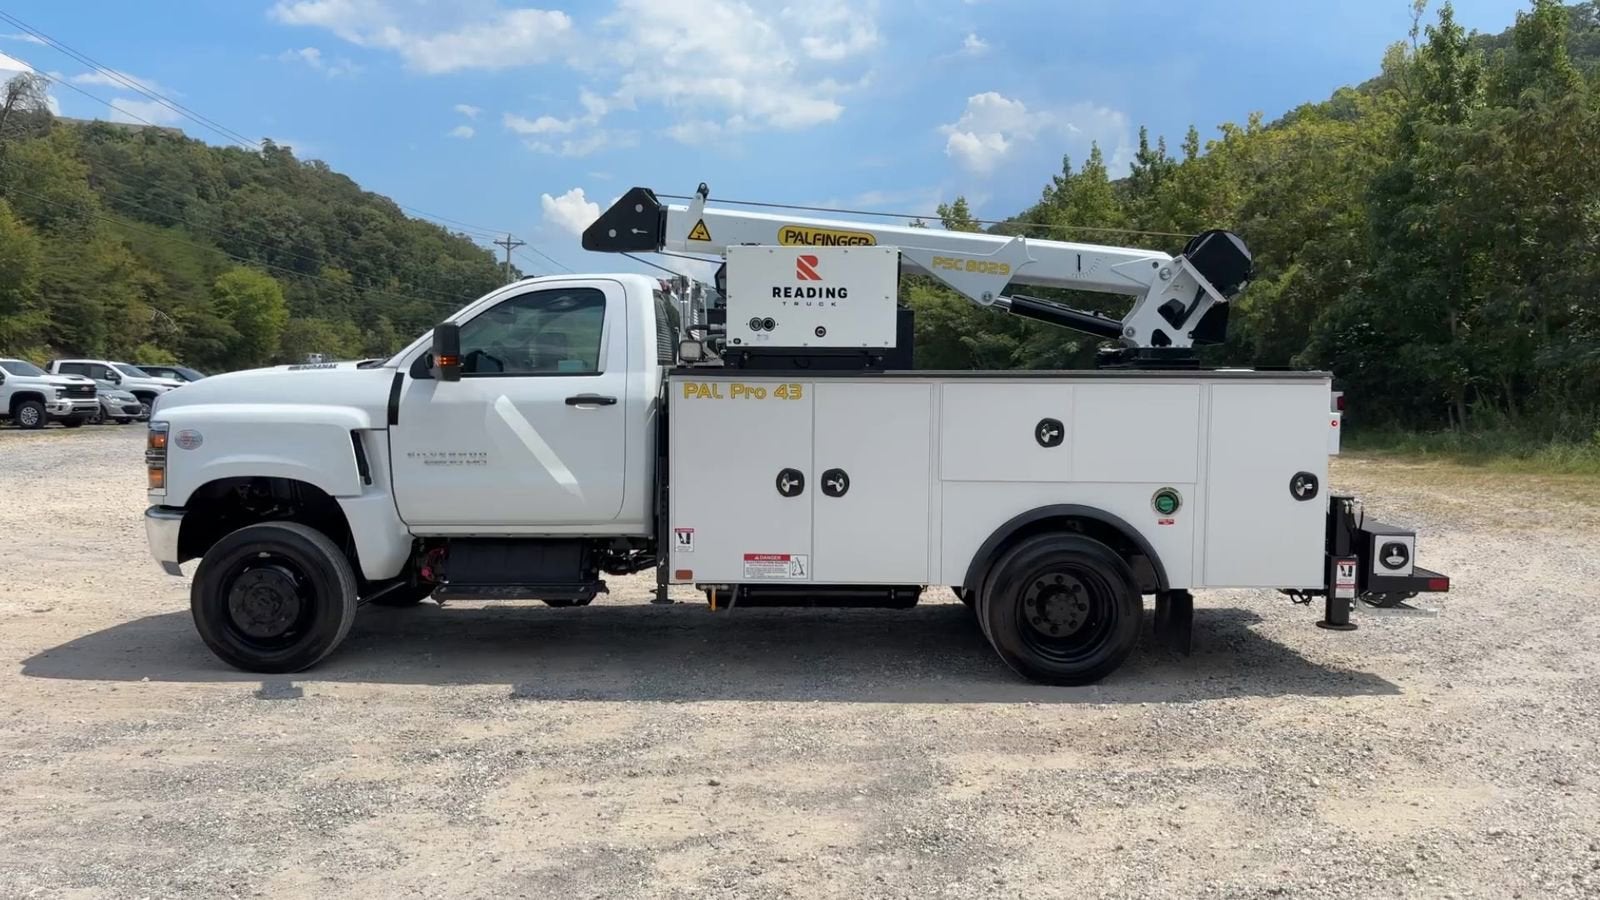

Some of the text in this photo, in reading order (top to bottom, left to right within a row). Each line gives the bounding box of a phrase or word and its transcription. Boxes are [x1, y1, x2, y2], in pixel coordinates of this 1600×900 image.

[784, 229, 871, 246] PALFINGER
[932, 256, 1010, 276] PSC 8029
[772, 286, 848, 299] READING
[683, 382, 803, 399] PAL Pro 43
